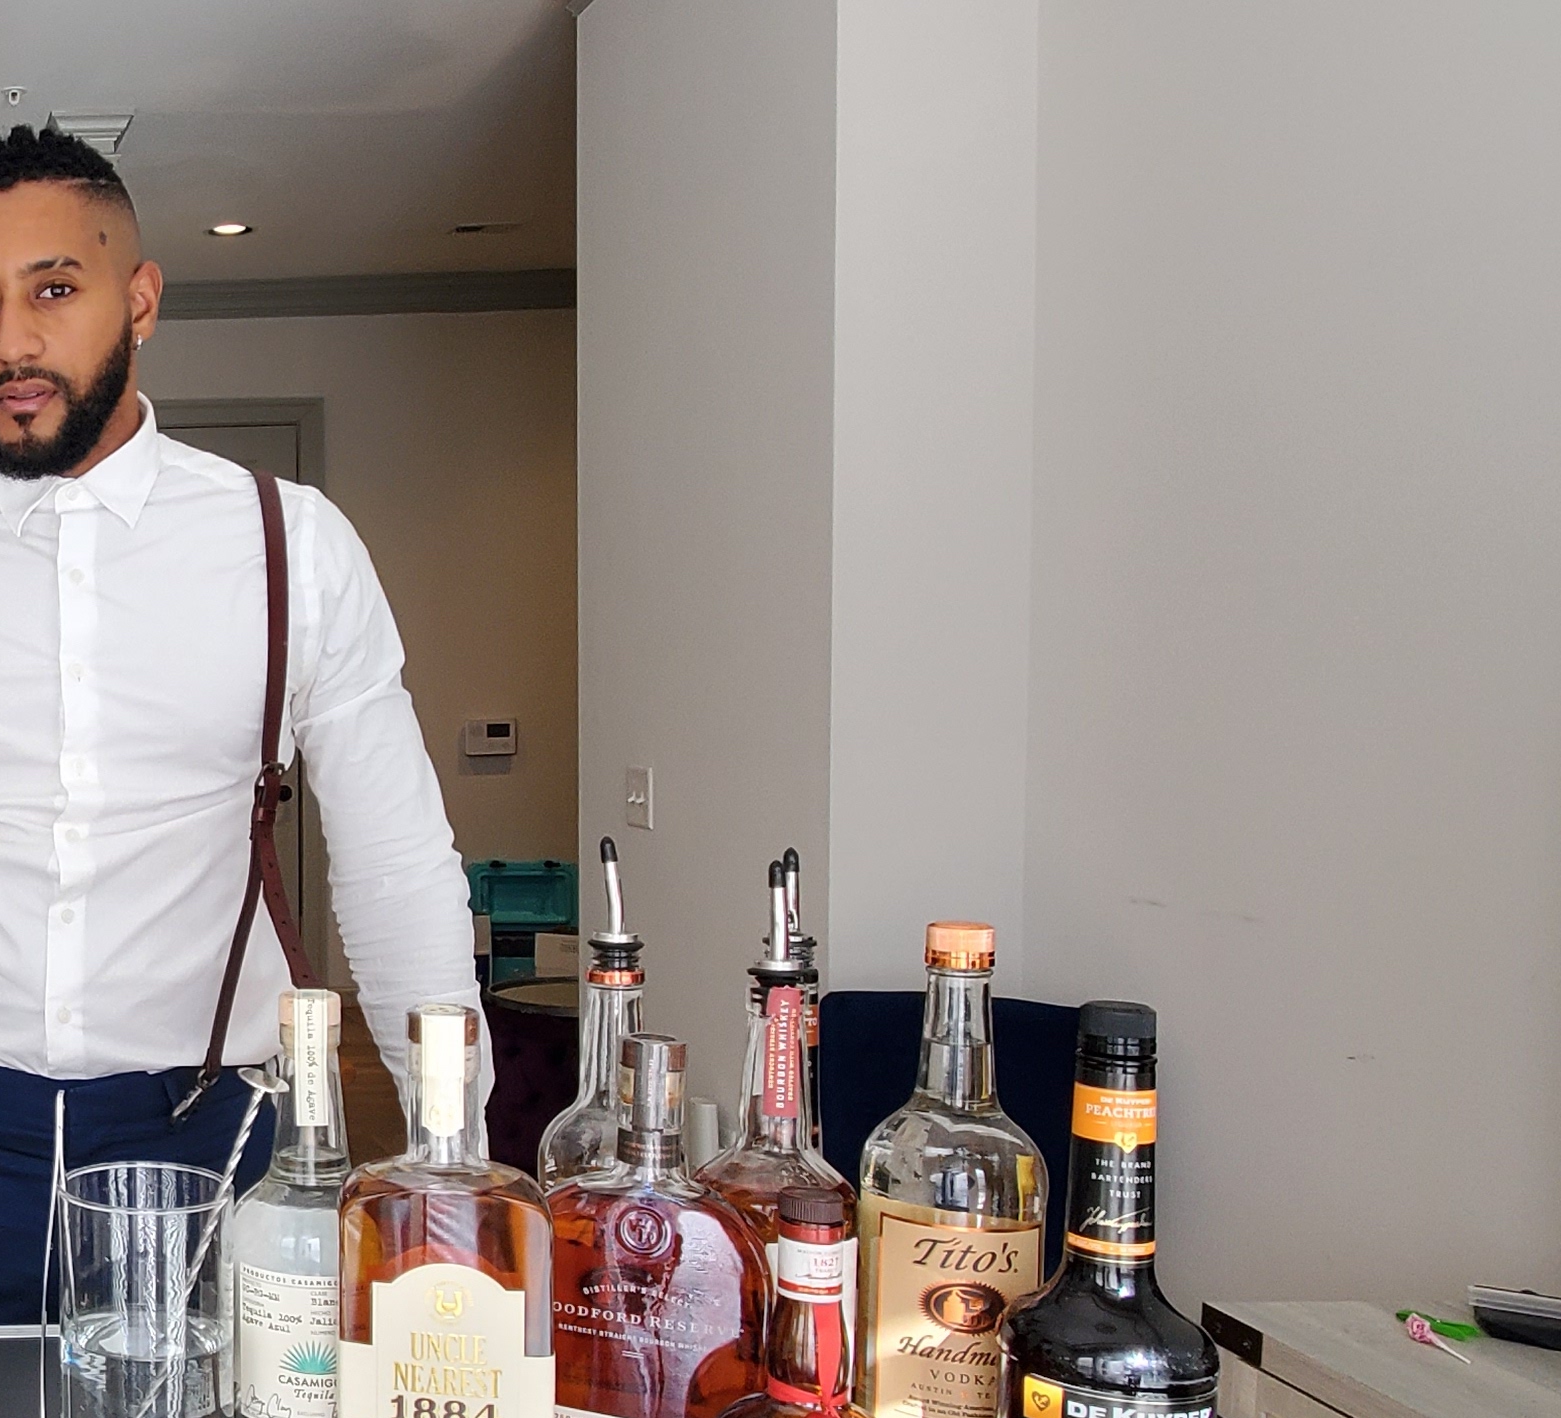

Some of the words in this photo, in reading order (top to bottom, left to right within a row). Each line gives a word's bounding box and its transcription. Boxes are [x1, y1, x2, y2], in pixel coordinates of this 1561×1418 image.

[305, 998, 315, 1039] Tequila
[778, 998, 790, 1050] WHISKEY
[775, 1055, 787, 1109] BOURBON
[306, 1090, 316, 1121] Agave
[1095, 1158, 1114, 1168] THE
[1121, 1161, 1151, 1169] BRAND
[1091, 1172, 1152, 1184] BARTENDERS
[1109, 1189, 1141, 1199] TRUST
[243, 1267, 287, 1284] PRODUCTOS
[583, 1284, 647, 1295] DISTILLER'S
[311, 1298, 338, 1307] Blan
[242, 1302, 272, 1320] Tequila
[278, 1313, 303, 1325] 100%
[310, 1317, 338, 1326] Jali
[552, 1301, 642, 1325] OODFORD
[649, 1315, 744, 1339] RESERVE
[242, 1315, 263, 1328] Agave
[268, 1322, 291, 1334] Azul
[410, 1331, 487, 1365] UNCLE
[897, 1335, 996, 1366] Handm
[278, 1374, 338, 1388] CASAMIG
[393, 1361, 502, 1398] NEAREST
[911, 1382, 953, 1395] AUSTIN
[294, 1388, 335, 1402] Tequila
